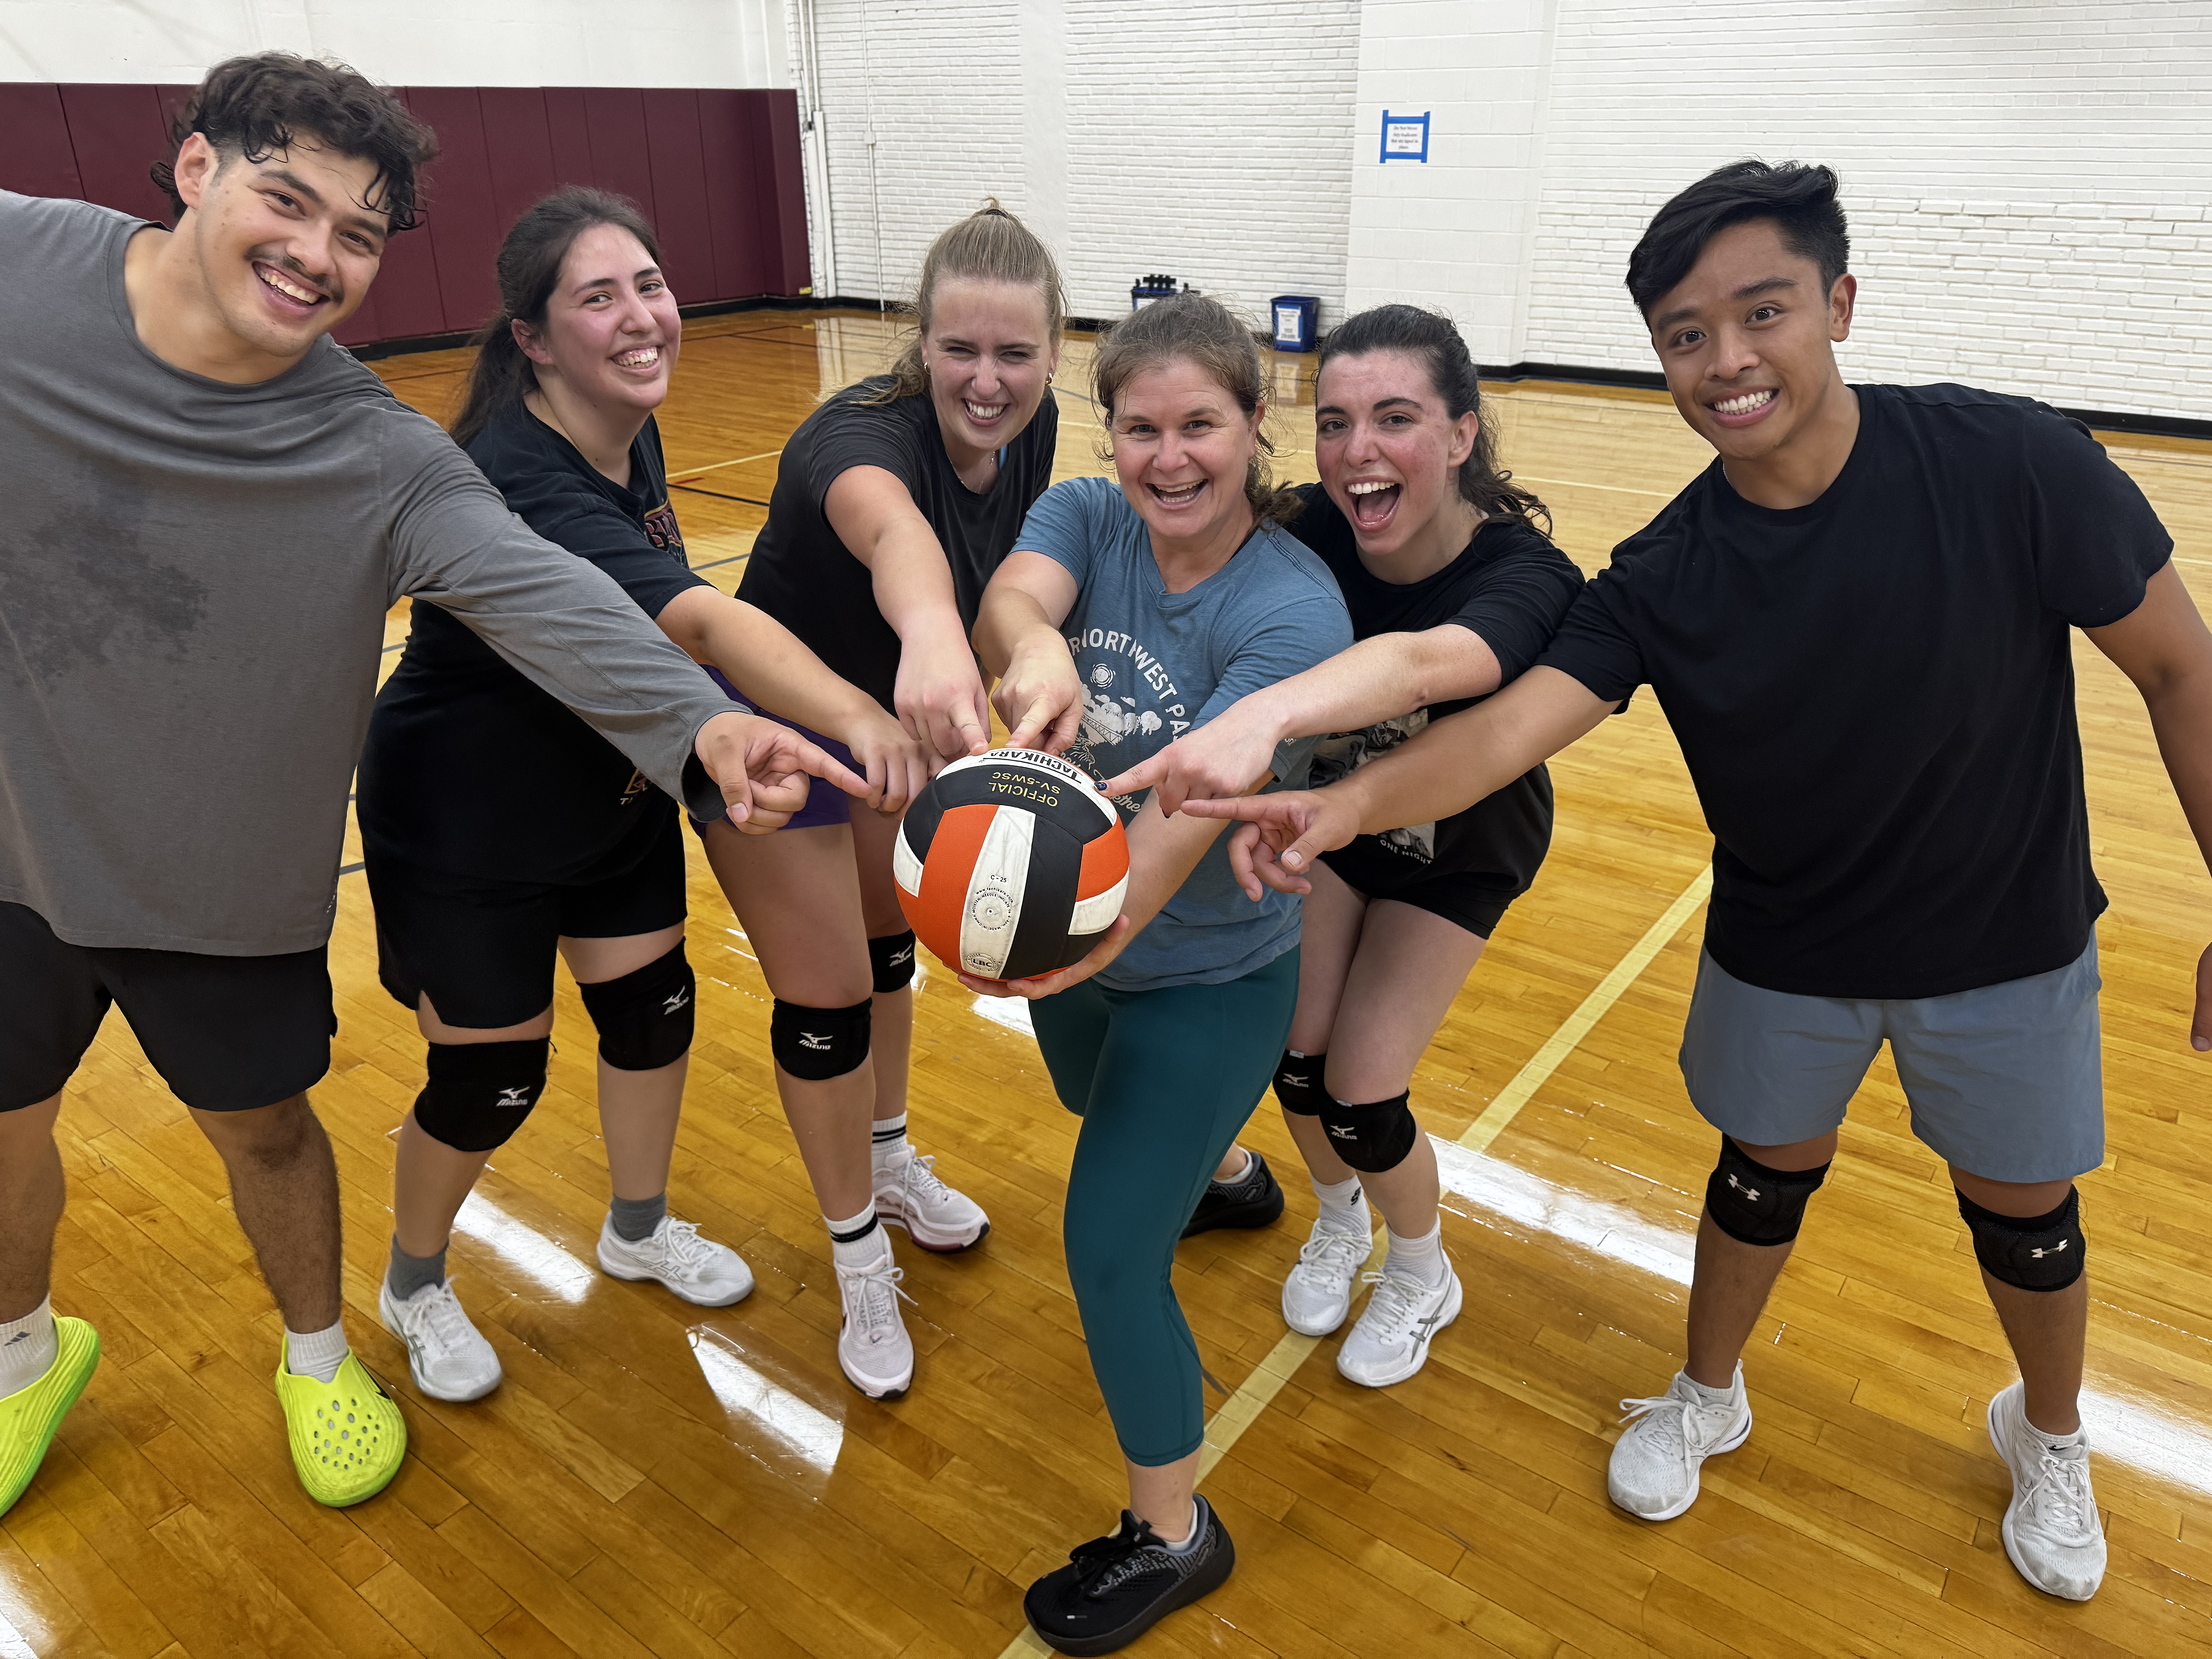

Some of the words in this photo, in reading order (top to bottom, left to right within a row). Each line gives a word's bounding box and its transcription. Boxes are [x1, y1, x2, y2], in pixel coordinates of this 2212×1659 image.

[1165, 704, 1190, 742] PA
[991, 751, 1081, 783] TACHIKARA
[988, 782, 1058, 807] OFFICIAL
[992, 772, 1061, 794] SV-5WSC
[1380, 840, 1398, 854] ONE
[1402, 851, 1432, 864] NIGHT
[973, 958, 992, 967] LBC
